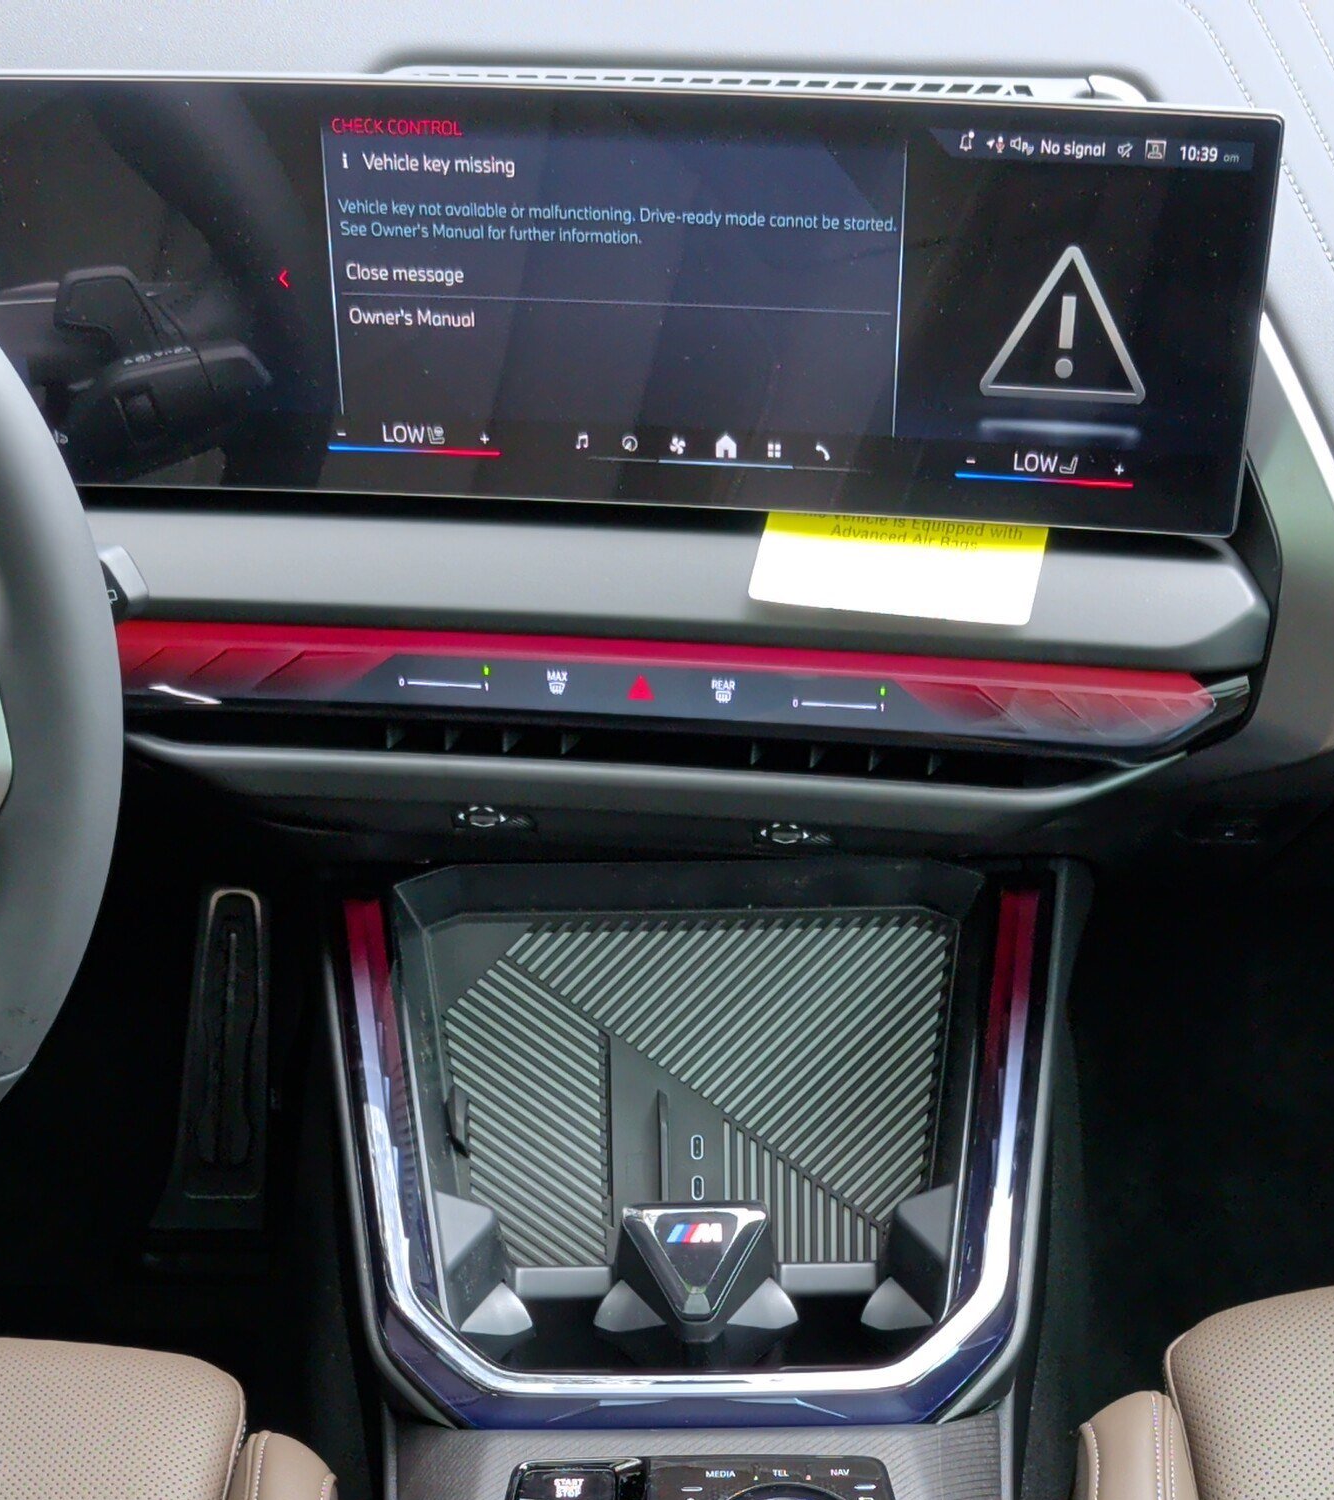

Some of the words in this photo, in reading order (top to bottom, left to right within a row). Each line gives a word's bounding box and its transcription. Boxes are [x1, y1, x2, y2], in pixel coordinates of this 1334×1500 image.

[332, 118, 383, 135] CHECK
[387, 119, 463, 137] CONTROL
[1040, 139, 1060, 155] No
[1064, 139, 1106, 158] signal
[1180, 145, 1218, 163] 10:39
[362, 152, 418, 172] Vehicle
[423, 155, 450, 176] key
[455, 157, 515, 178] missing
[338, 198, 388, 216] Vehicle
[391, 200, 416, 218] key
[419, 202, 441, 217] not
[445, 202, 507, 219] available
[511, 205, 525, 219] or
[529, 203, 636, 224] malfunctioning.
[640, 207, 721, 227] Drive-ready
[725, 211, 766, 227] mode
[769, 213, 818, 229] cannot
[822, 214, 839, 230] be
[843, 216, 897, 233] started.
[340, 221, 367, 237] See
[371, 222, 429, 239] Owner's
[433, 224, 484, 240] Manual
[487, 225, 505, 241] for
[509, 226, 555, 243] further
[559, 226, 642, 245] information.
[346, 263, 389, 281] Close
[393, 268, 464, 287] message
[349, 307, 413, 326] Owner's
[417, 310, 475, 328] Manual
[382, 423, 424, 444] LOW
[1013, 452, 1057, 473] LOW
[830, 523, 907, 542] Advanced
[991, 523, 1023, 541] with
[398, 677, 405, 686] 0
[546, 670, 567, 681] MAX
[711, 679, 736, 690] REAR
[792, 697, 799, 708] 0
[705, 1469, 736, 1478] MEDIA
[772, 1469, 789, 1477] TEL
[830, 1468, 850, 1476] NAV
